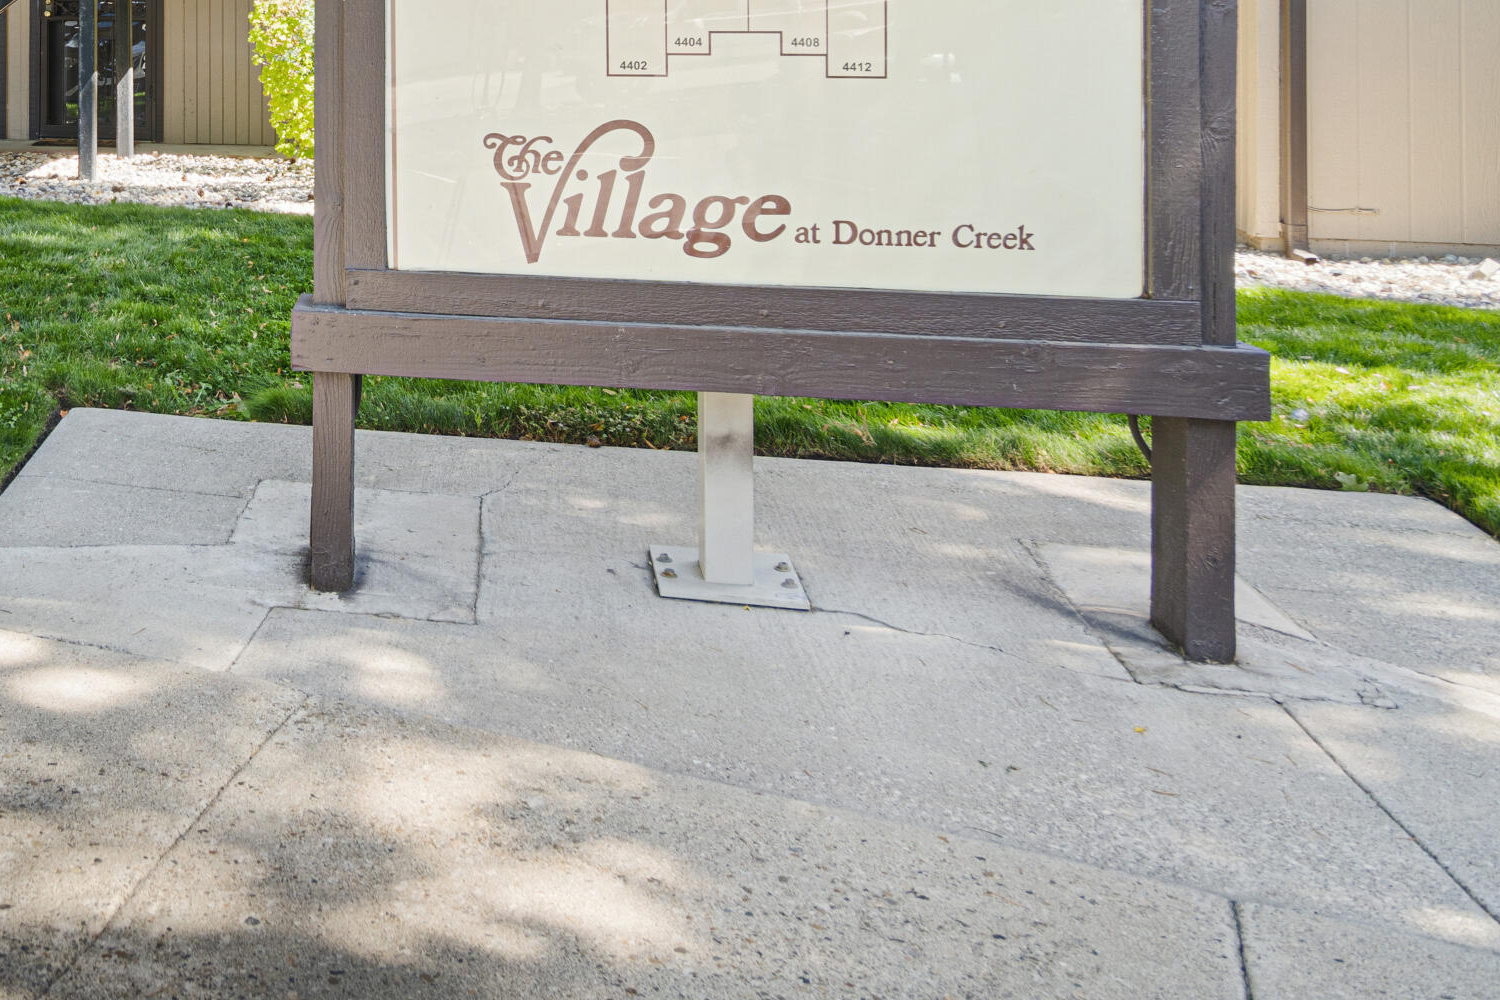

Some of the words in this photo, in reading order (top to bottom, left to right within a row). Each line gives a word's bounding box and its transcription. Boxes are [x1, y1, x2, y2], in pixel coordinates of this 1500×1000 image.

[674, 37, 702, 47] 4404
[791, 37, 820, 48] 4408
[619, 60, 648, 71] 4402
[842, 62, 872, 72] 4412
[483, 132, 564, 181] The
[500, 119, 792, 264] Village
[794, 223, 821, 245] at
[831, 219, 942, 248] Donner
[951, 223, 1036, 251] Creek
